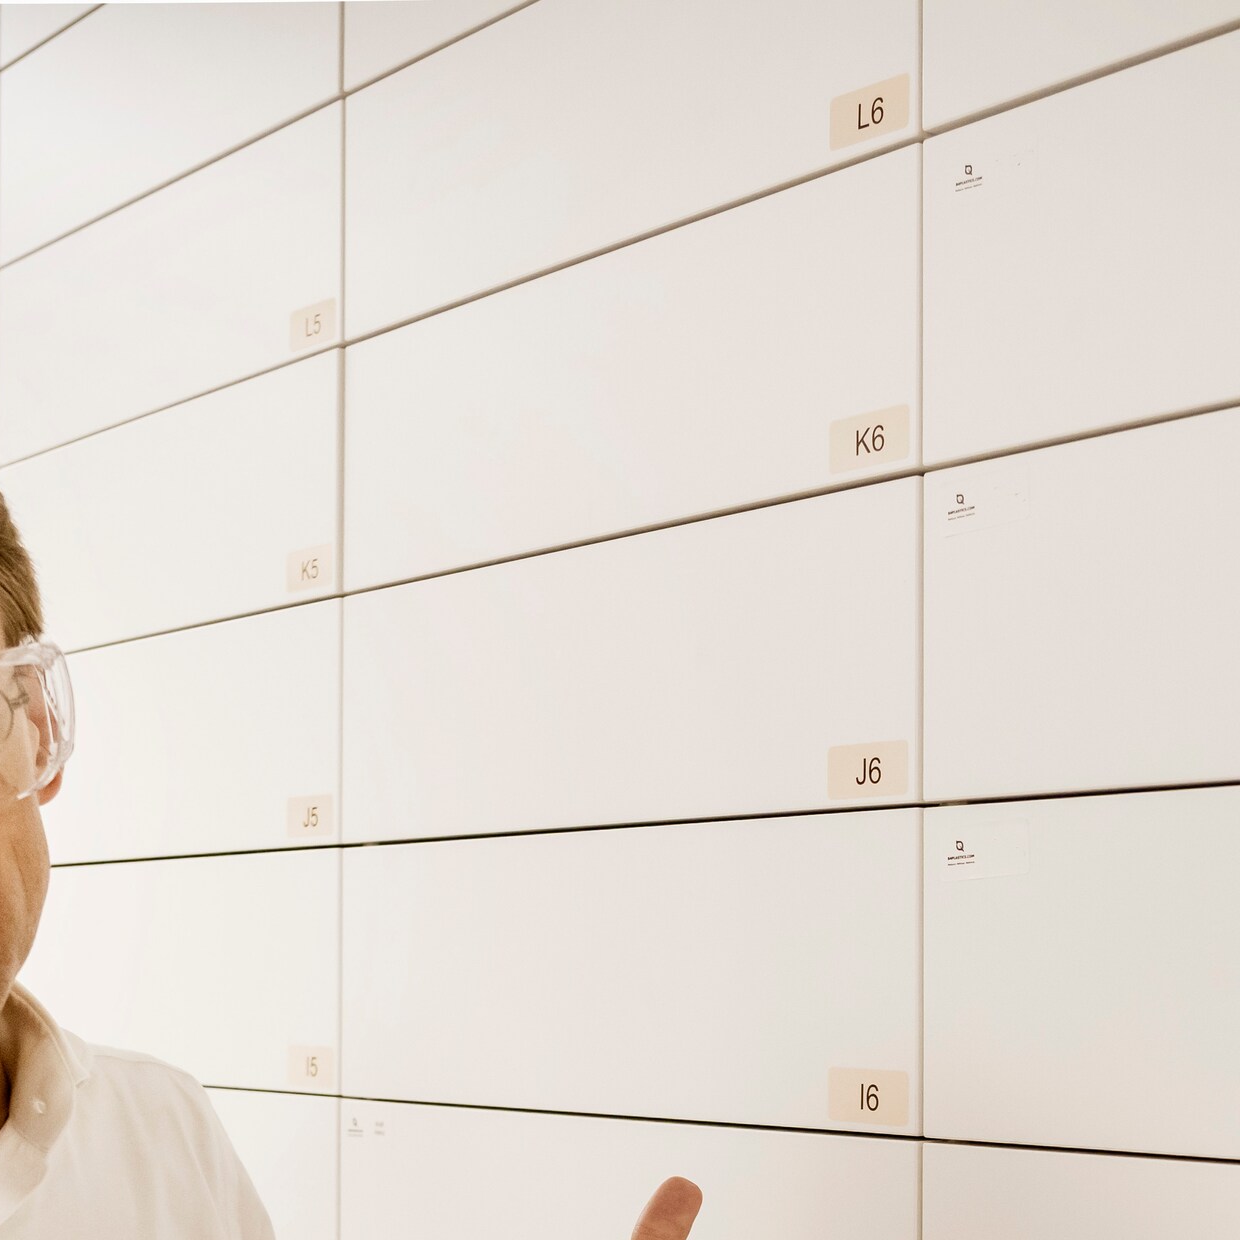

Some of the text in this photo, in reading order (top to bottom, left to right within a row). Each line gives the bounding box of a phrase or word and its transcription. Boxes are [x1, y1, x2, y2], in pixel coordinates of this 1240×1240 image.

[857, 96, 884, 130] L6
[305, 313, 321, 337] L5
[855, 424, 885, 457] K6
[301, 558, 319, 581] K5
[855, 756, 882, 786] J6
[303, 806, 319, 828] J5
[860, 1083, 879, 1112] I6
